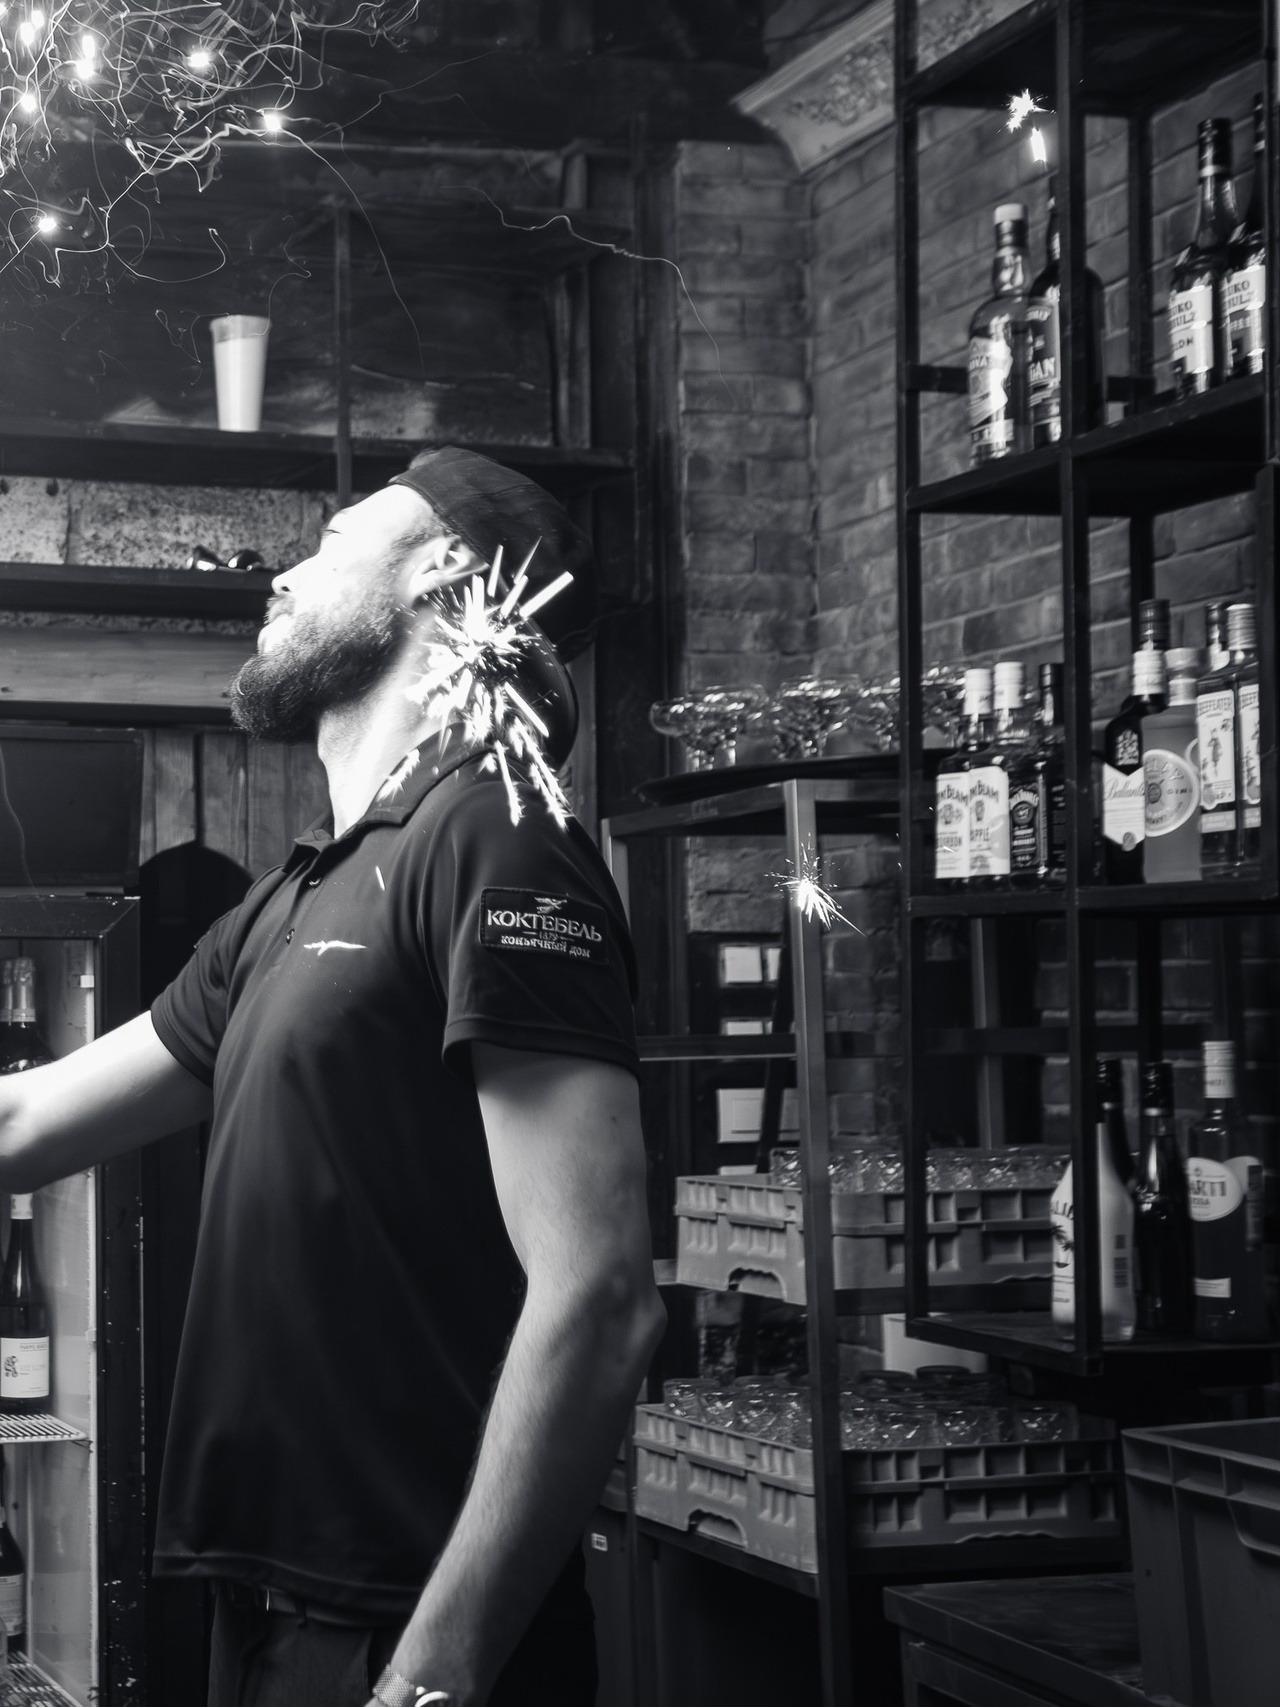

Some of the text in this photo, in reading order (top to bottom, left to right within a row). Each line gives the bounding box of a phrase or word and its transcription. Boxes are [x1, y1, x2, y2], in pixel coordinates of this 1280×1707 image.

[1029, 357, 1055, 382] GAN
[487, 909, 602, 943] КОКТЕБЕЛЬ
[500, 935, 590, 958] КОНЬЯЧНЫЙ ДОМ
